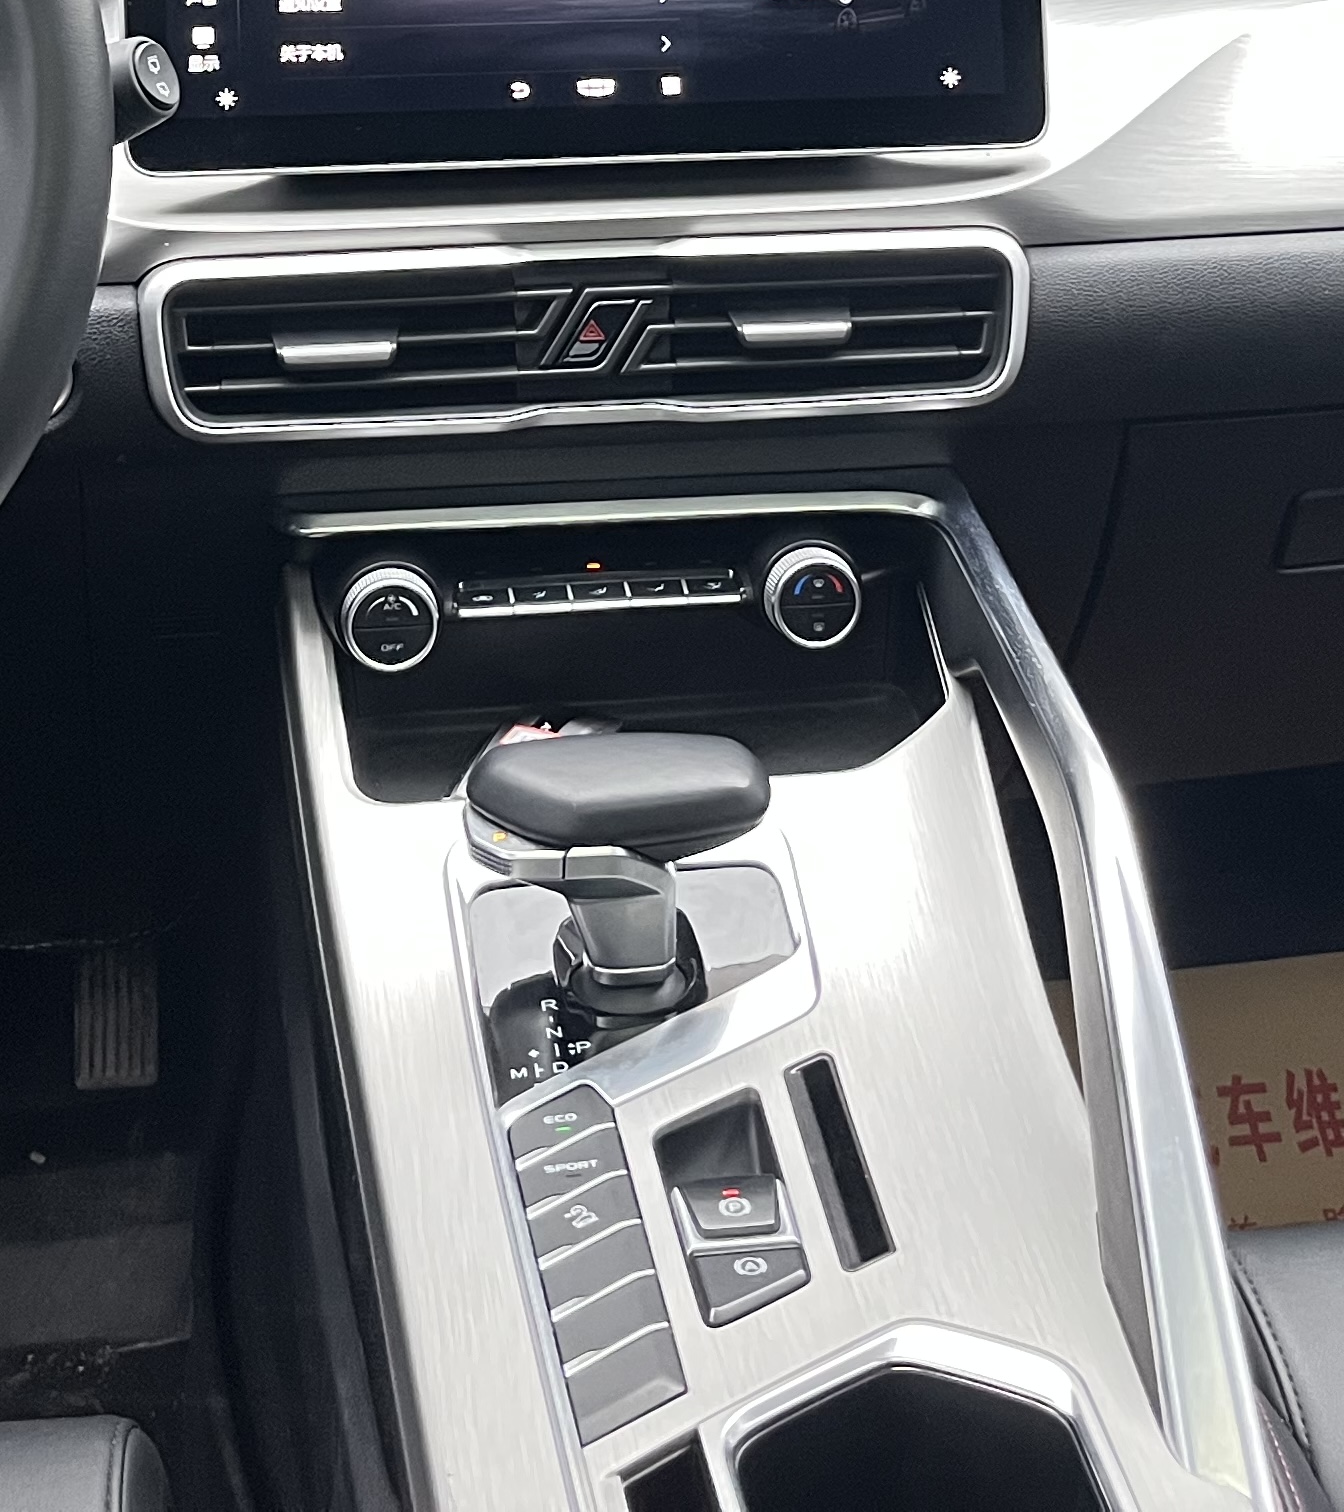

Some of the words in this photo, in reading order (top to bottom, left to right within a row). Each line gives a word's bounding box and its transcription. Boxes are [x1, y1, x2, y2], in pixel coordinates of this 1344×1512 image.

[280, 43, 345, 63] 关于本机
[380, 643, 404, 652] OFF
[540, 998, 559, 1012] R
[545, 1026, 563, 1039] N
[575, 1040, 592, 1054] P
[509, 1066, 528, 1080] M
[552, 1061, 569, 1074] D
[543, 1112, 578, 1125] ECO
[543, 1159, 599, 1174] SPORT
